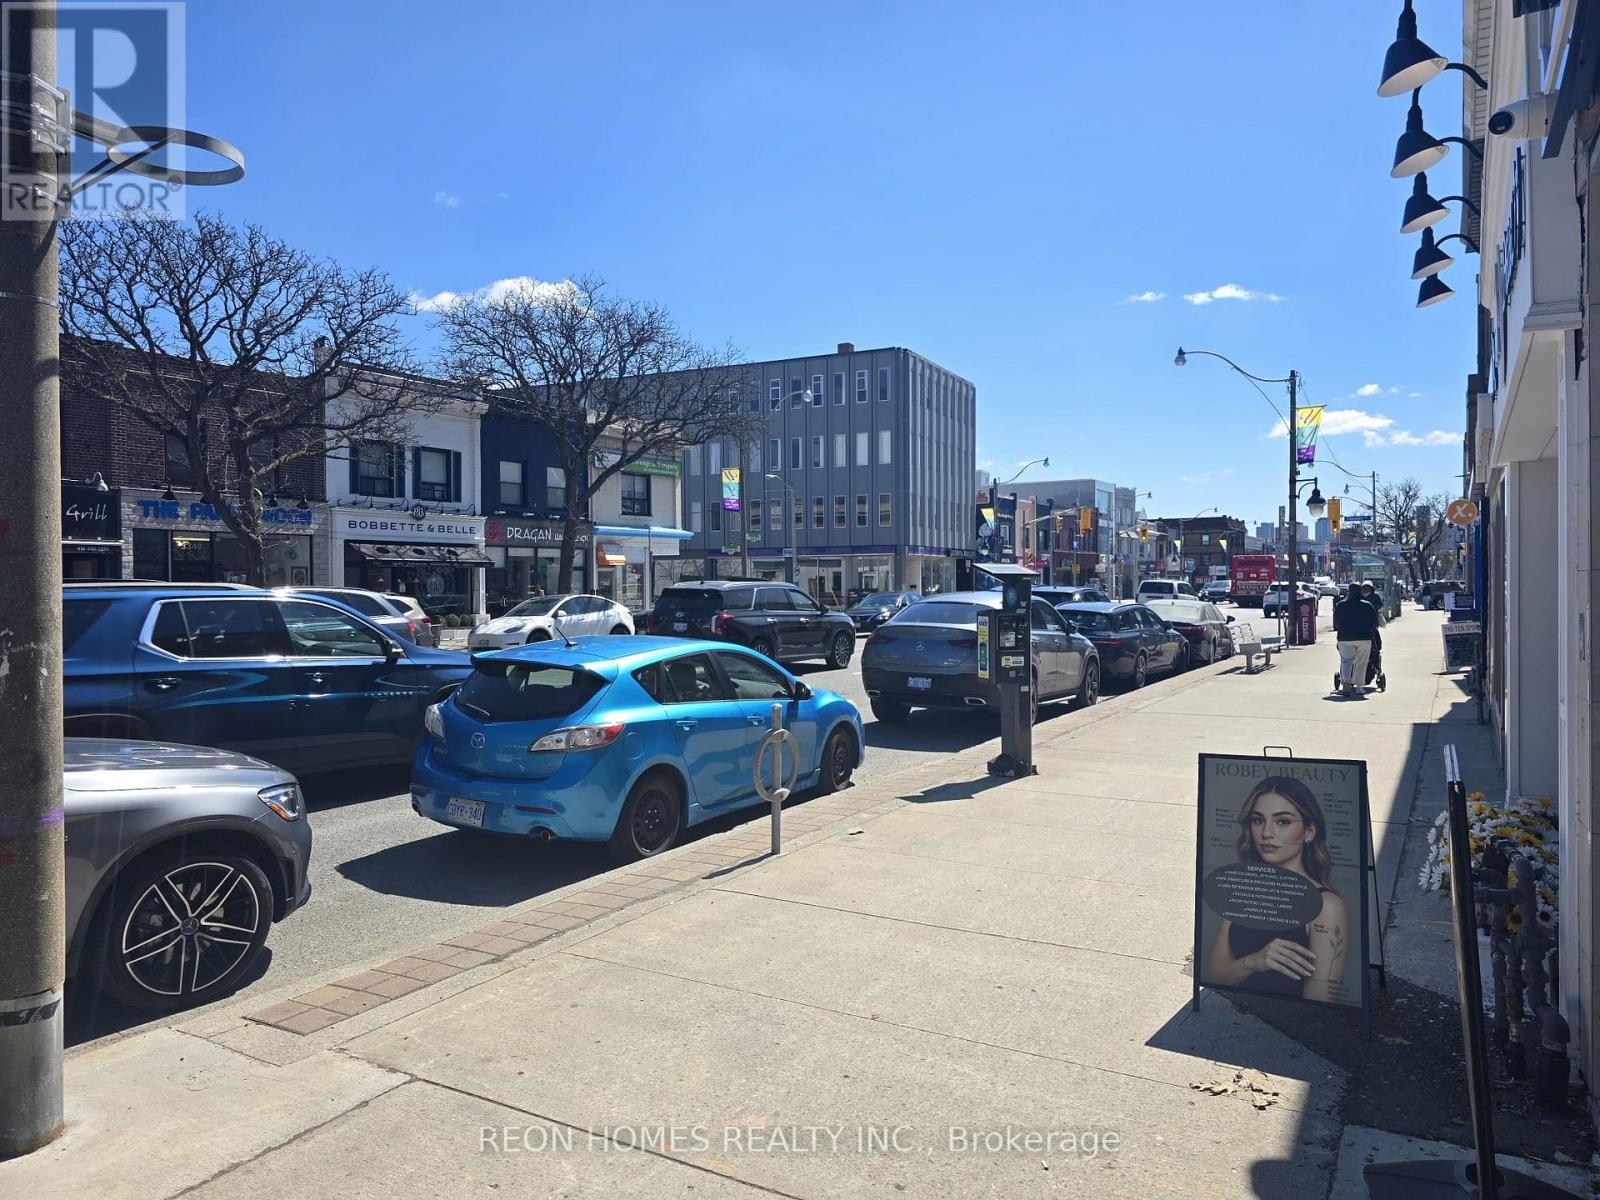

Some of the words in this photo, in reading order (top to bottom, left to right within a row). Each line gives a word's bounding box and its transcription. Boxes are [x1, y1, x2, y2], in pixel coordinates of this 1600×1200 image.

[66, 503, 108, 521] Grill
[348, 520, 424, 532] BOBBETTE
[427, 524, 435, 532] &
[437, 525, 477, 534] BELLE
[506, 527, 552, 542] DRAGAN
[1215, 762, 1273, 778] ROBEY
[1278, 766, 1351, 783] BEAUTY
